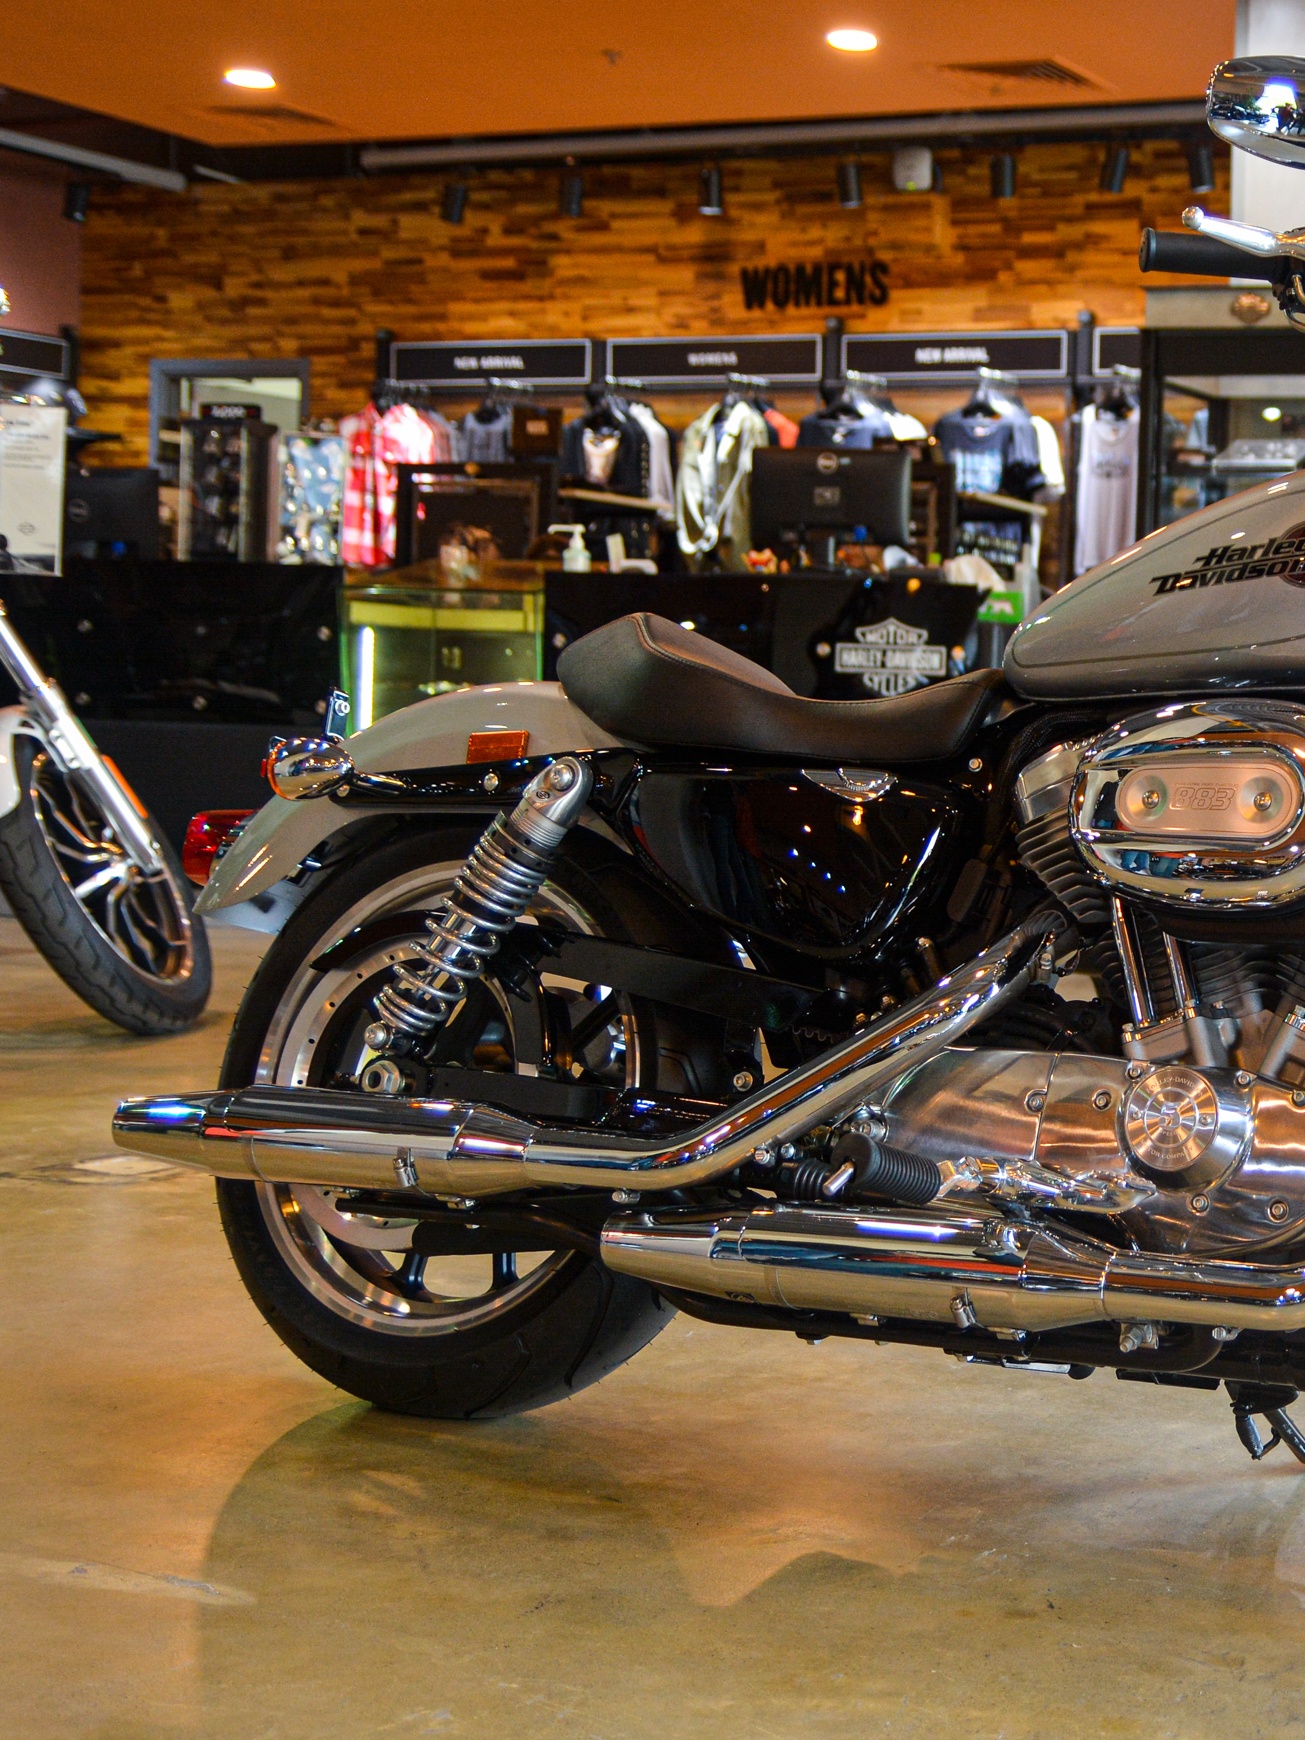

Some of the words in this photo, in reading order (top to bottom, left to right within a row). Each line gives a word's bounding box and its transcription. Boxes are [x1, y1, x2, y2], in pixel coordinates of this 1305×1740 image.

[740, 260, 890, 311] WOMENS
[914, 347, 942, 364] NEW
[943, 347, 991, 364] ARRIVAL
[864, 624, 920, 644] MOTOR
[841, 648, 941, 670] HARLEY-DAVIDSON
[1168, 787, 1236, 811] 883
